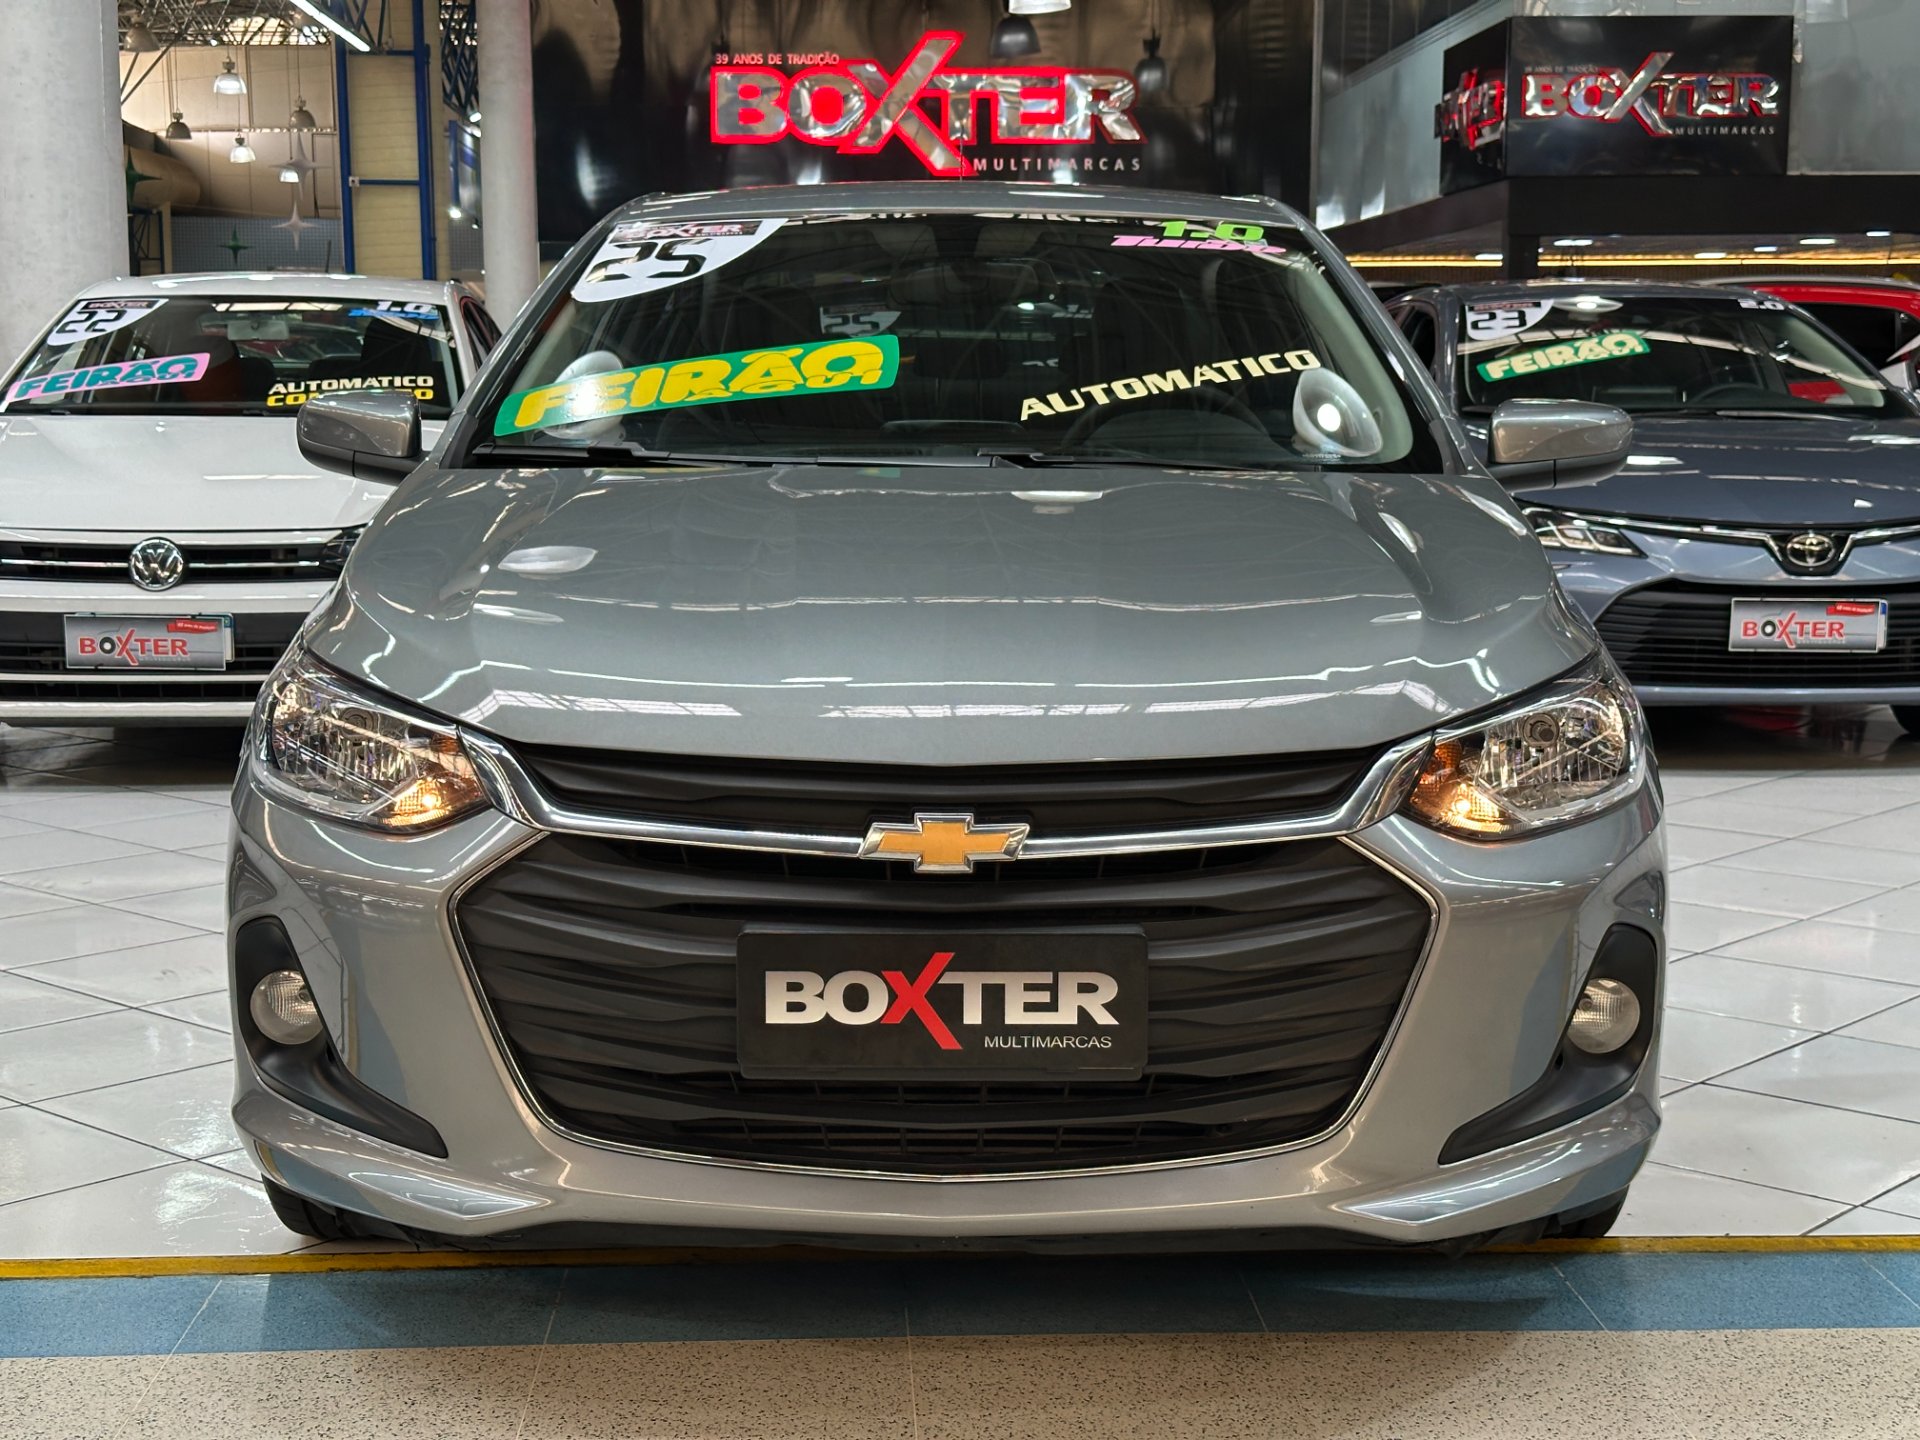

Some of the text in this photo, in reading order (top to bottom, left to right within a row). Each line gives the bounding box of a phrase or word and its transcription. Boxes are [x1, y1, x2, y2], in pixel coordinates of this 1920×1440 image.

[715, 51, 840, 66] 39 ANOS DE TRADIÇÃO
[711, 30, 1147, 176] BOXTER
[1521, 51, 1780, 136] BOXTER
[1675, 127, 1776, 136] MULTIMARCAS
[973, 157, 1142, 172] MULTIMARCAS
[1157, 221, 1265, 241] 1.0
[584, 238, 714, 284] 25
[56, 310, 127, 334] 22
[376, 301, 433, 313] 1.0
[1471, 310, 1527, 330] 23
[1486, 334, 1643, 379] FEIRÃO
[14, 356, 199, 399] FEIRÃO
[268, 375, 434, 395] AUTOMATICO
[515, 341, 884, 428] FEIRÃO
[1020, 350, 1321, 421] AUTOMATICO
[78, 628, 190, 666] BOXTER
[1741, 611, 1845, 648] BOXTER
[765, 952, 1119, 1050] BOXTER
[984, 1036, 1112, 1048] MULTIMARCAS
